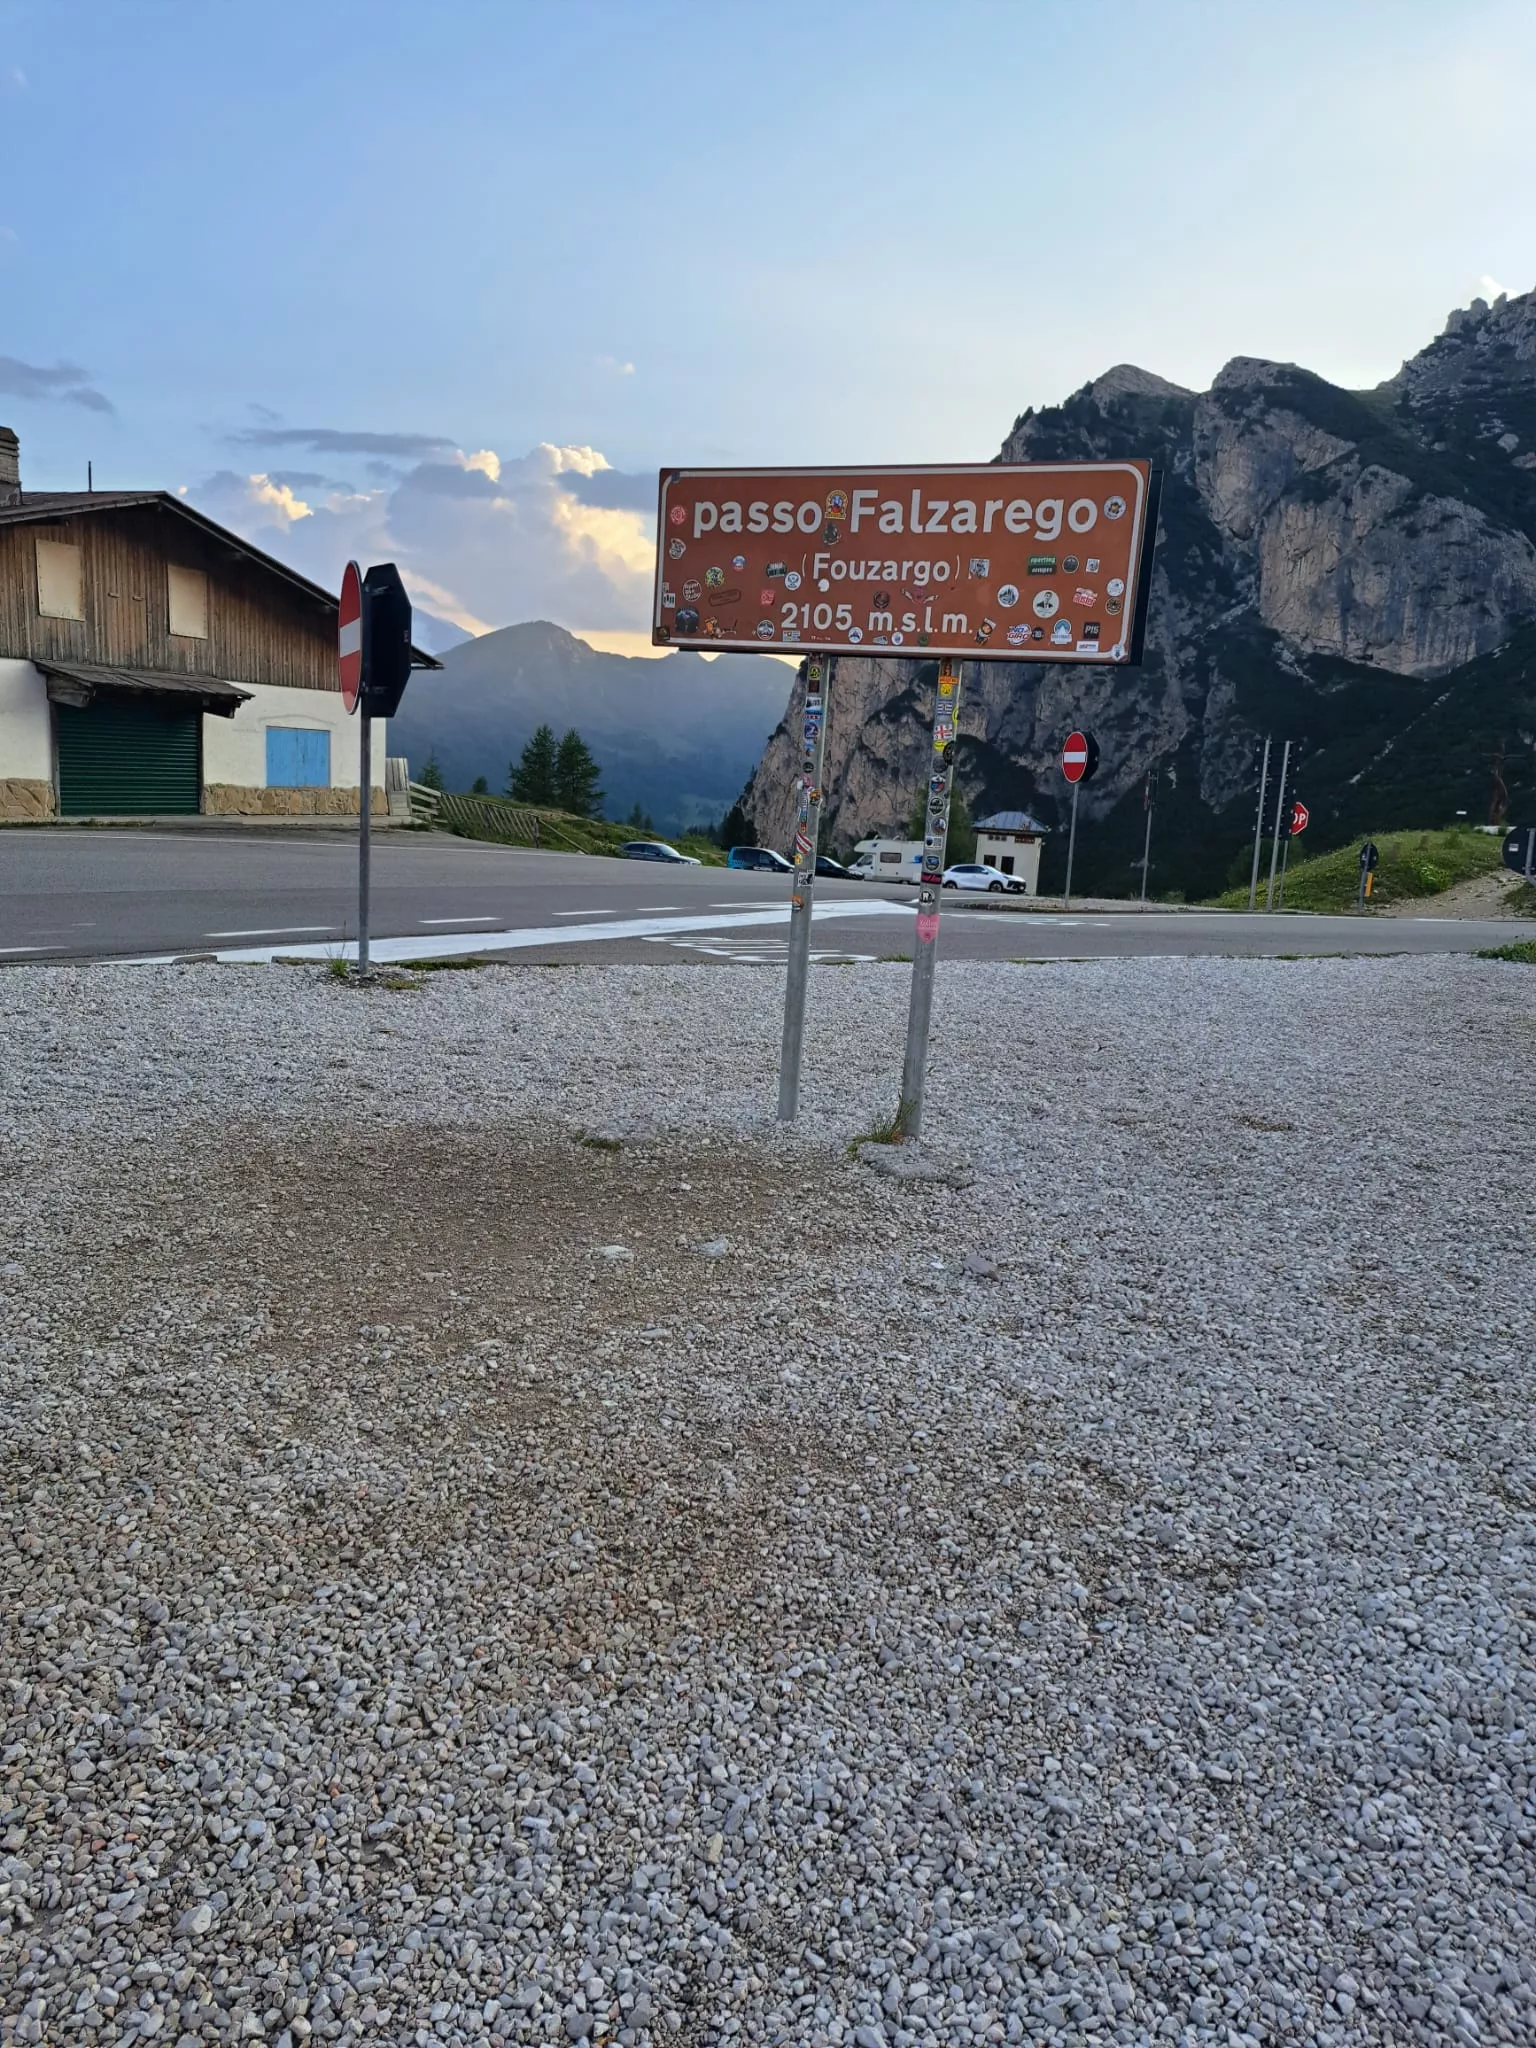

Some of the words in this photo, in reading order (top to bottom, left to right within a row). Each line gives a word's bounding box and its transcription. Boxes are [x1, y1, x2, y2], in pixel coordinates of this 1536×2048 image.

[693, 501, 823, 539] passo
[850, 489, 1098, 541] Falzarego
[781, 602, 853, 630] 2105
[868, 606, 973, 633] m.s.l.m.
